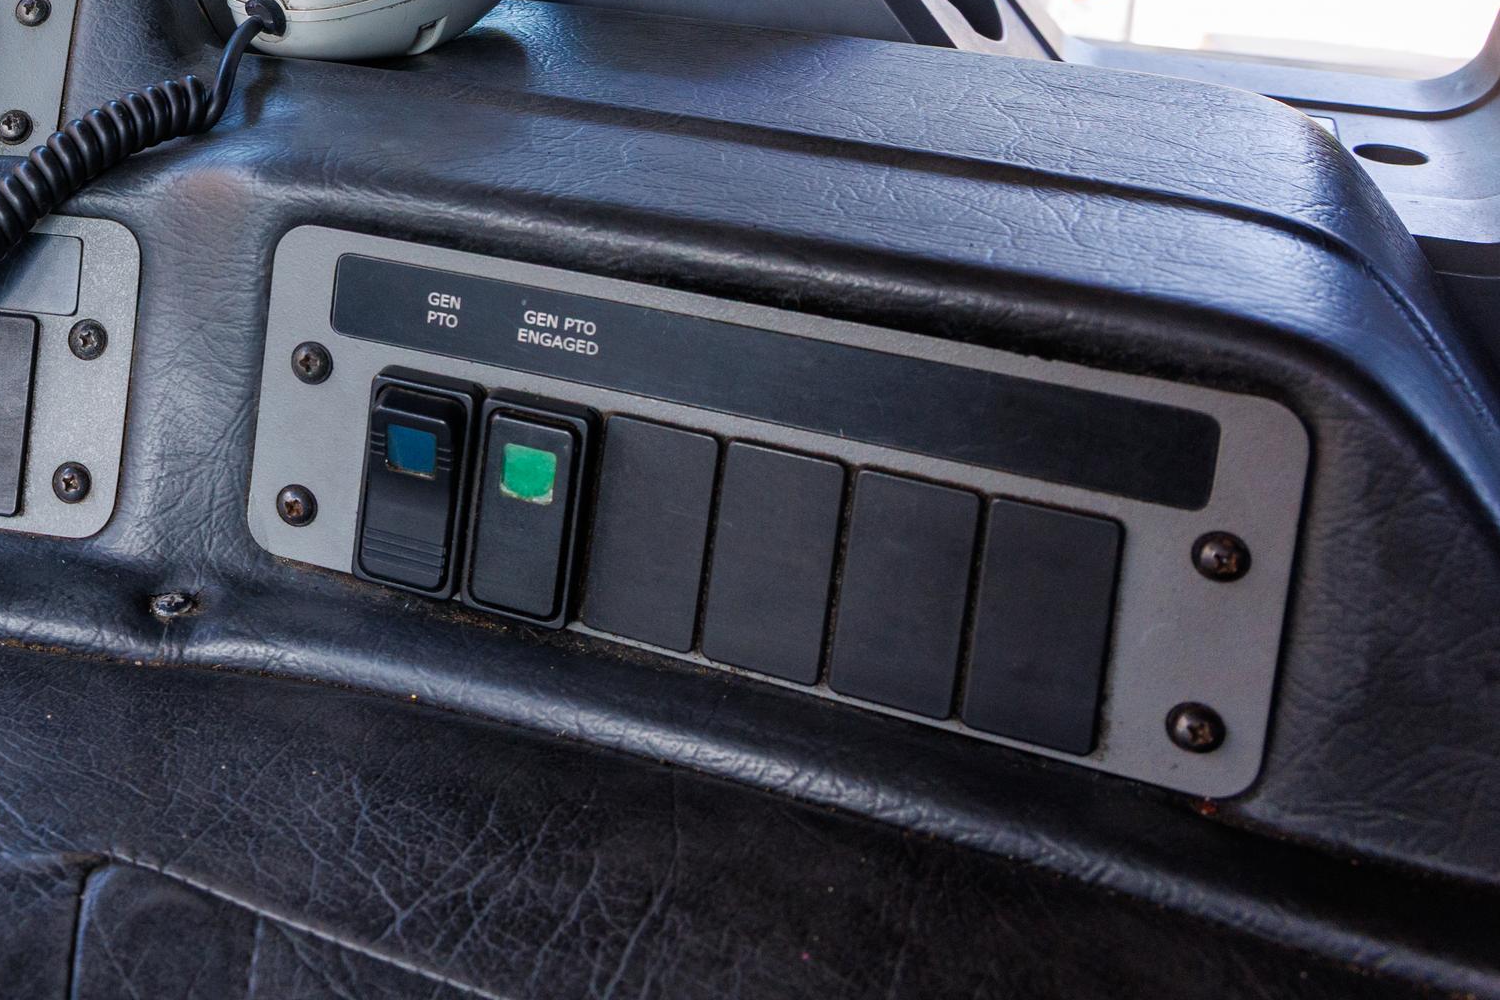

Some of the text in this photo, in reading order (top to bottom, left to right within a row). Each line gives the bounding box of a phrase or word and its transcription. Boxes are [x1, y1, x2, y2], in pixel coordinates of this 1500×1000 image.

[427, 292, 462, 310] GEN
[427, 310, 459, 328] PTO
[523, 310, 597, 336] GEN PTO
[517, 328, 600, 356] ENGAGED
